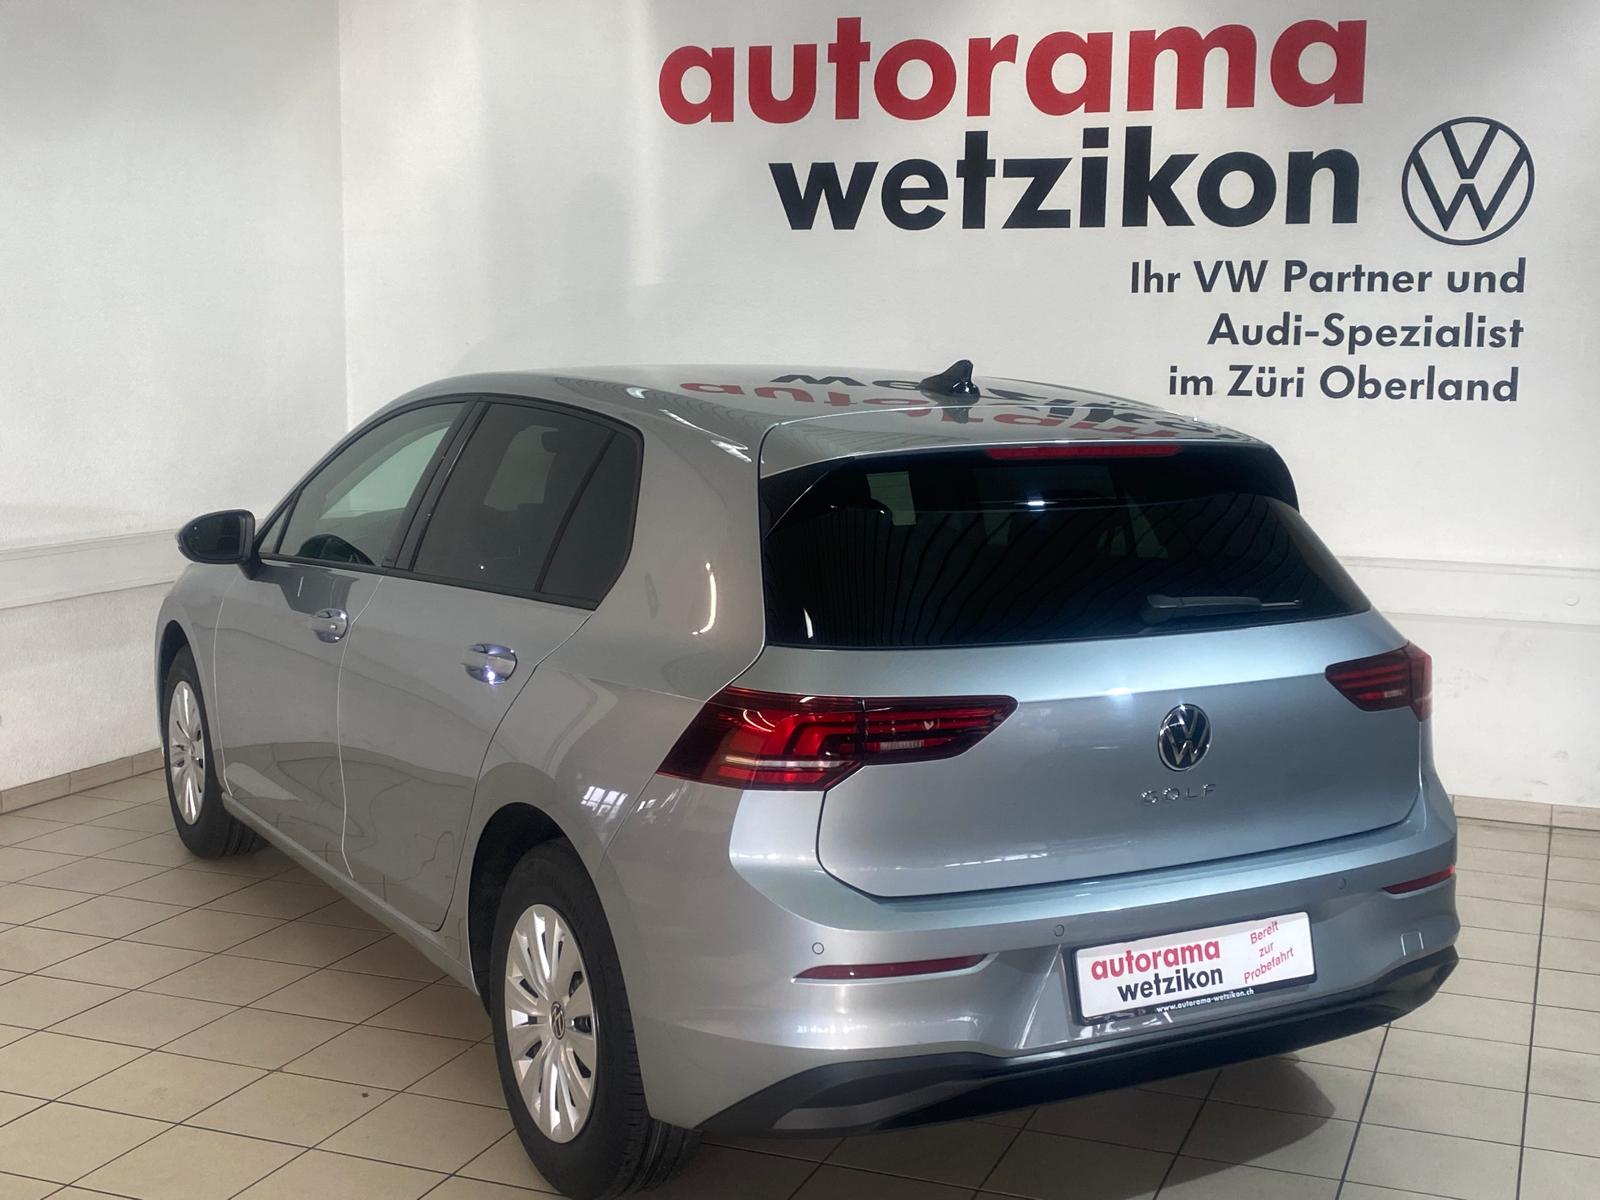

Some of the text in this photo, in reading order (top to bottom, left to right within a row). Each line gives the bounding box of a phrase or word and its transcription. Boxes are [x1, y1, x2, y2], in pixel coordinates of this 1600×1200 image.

[659, 16, 1366, 124] autorama
[769, 126, 1360, 230] wetzikon
[1131, 257, 1526, 294] Ihr VW Partner und
[1207, 311, 1524, 355] Audi-Spezialist
[1169, 364, 1519, 402] im Züri Oberland
[1141, 783, 1217, 804] GOLF
[1250, 920, 1279, 944] Bereit
[1259, 942, 1275, 957] zur
[1091, 940, 1220, 980] autorama
[1244, 947, 1295, 984] Probefahrt
[1117, 967, 1224, 1002] wetzikon
[1156, 988, 1254, 1013] www.autorama-wetzikon.ch
